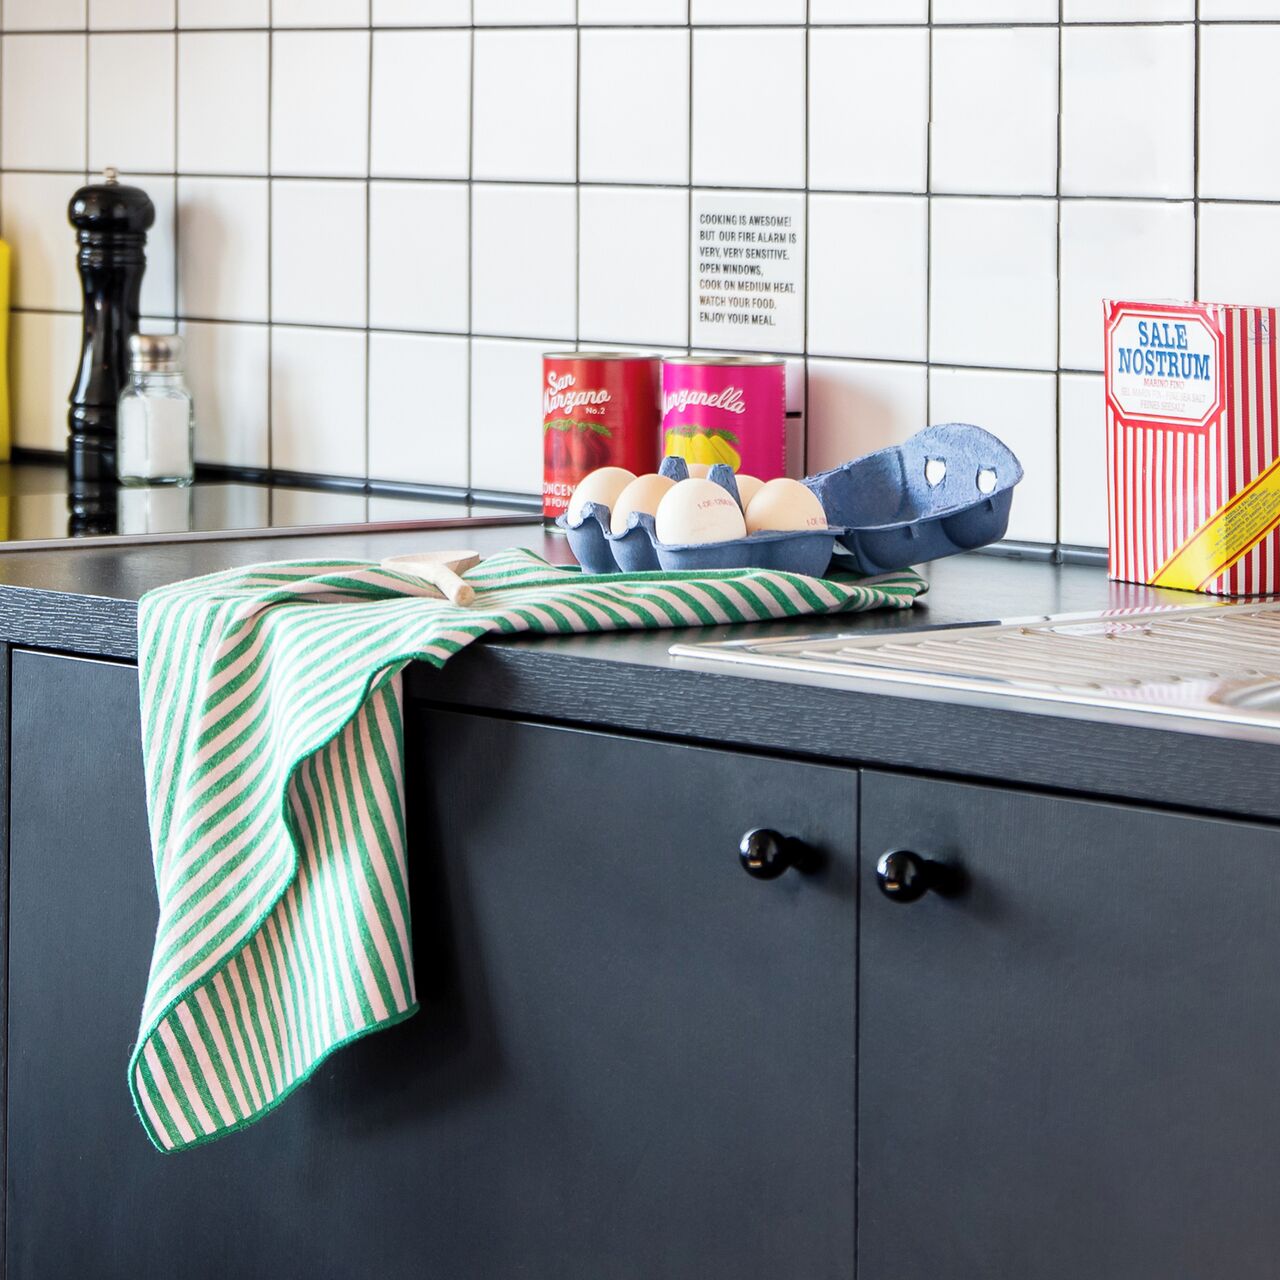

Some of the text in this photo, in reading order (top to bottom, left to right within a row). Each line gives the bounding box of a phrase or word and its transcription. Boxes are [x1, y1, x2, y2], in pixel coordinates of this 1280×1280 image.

[700, 214, 792, 227] COOKING IS AWESOME!
[700, 230, 797, 244] BUT OUR FIRE ALARM IS
[723, 247, 744, 258] VERY
[700, 263, 720, 274] OPEN
[700, 279, 721, 290] COOK
[724, 280, 735, 290] ON
[738, 281, 771, 292] MEDIUM
[700, 295, 726, 306] WATCH
[728, 296, 750, 308] YOUR
[700, 312, 725, 323] ENJOY
[727, 313, 749, 324] YOUR
[1138, 321, 1188, 350] SALE
[1118, 347, 1211, 381] NOSTRUM
[548, 371, 576, 396] San
